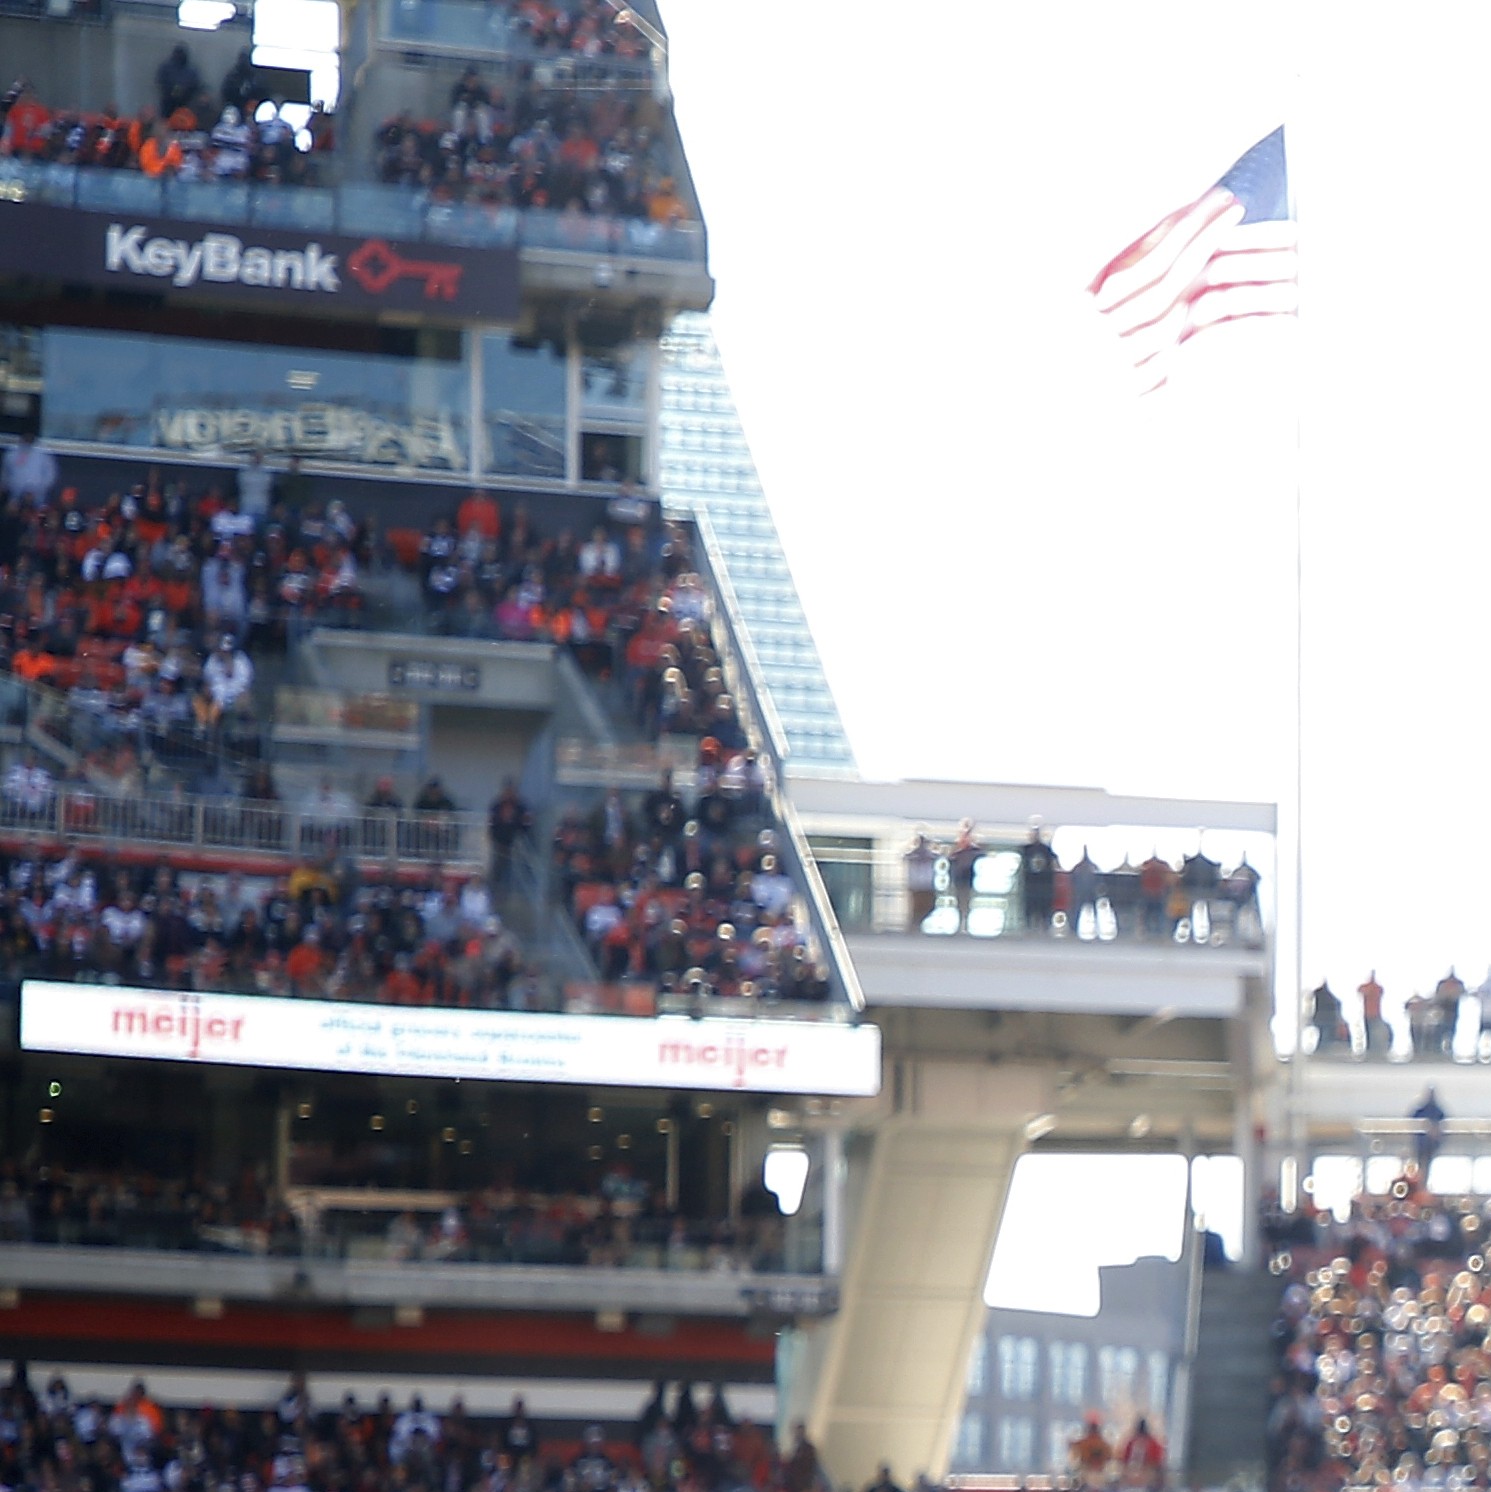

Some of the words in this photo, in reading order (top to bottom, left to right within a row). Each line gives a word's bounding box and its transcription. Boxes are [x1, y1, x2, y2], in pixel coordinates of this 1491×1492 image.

[105, 223, 342, 293] KeyBank
[112, 994, 246, 1058] meijer
[658, 1031, 788, 1088] meijer
